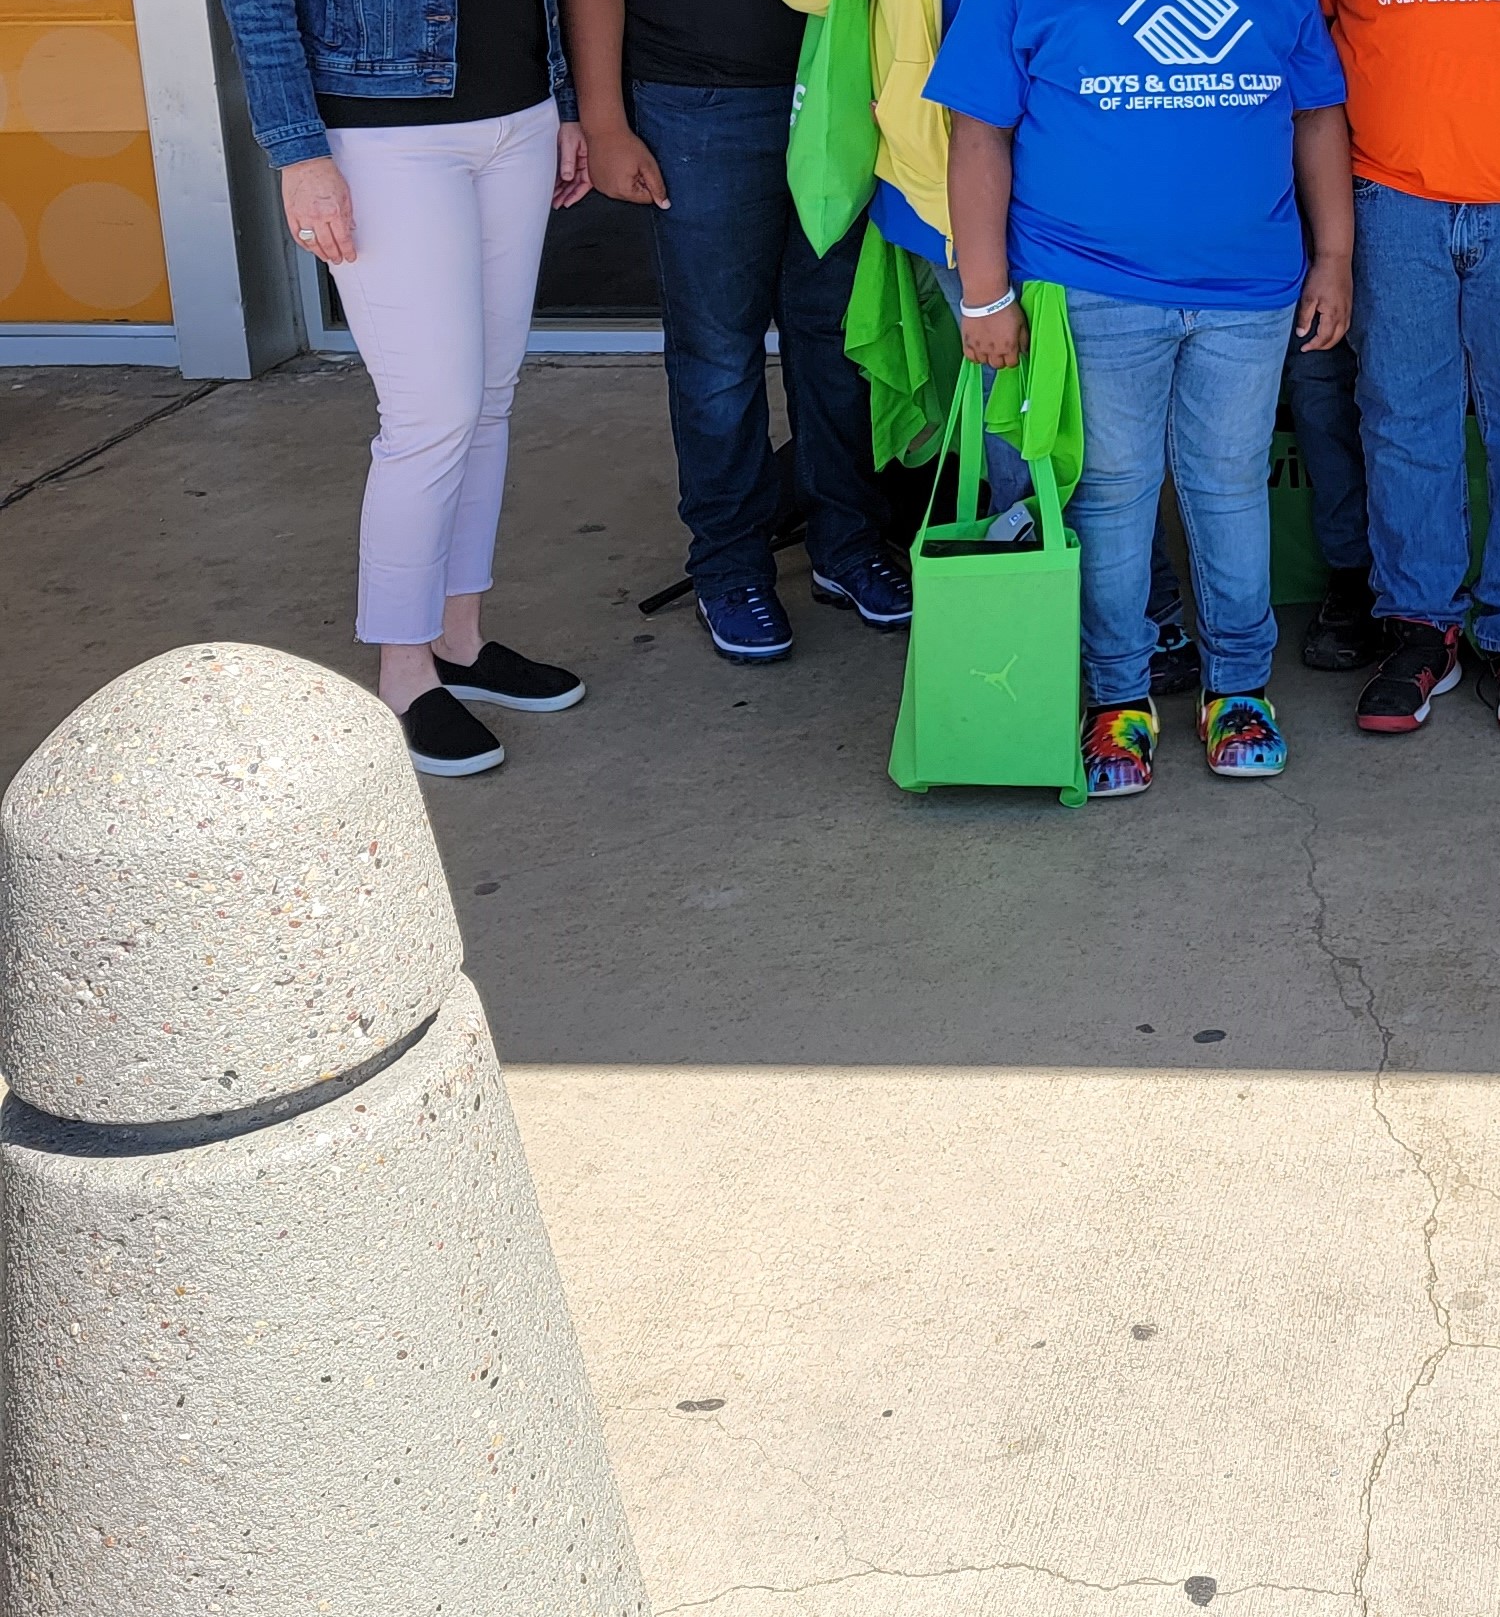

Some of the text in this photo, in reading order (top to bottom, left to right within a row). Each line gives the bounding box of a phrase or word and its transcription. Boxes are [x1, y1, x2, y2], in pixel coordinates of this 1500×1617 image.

[1079, 74, 1140, 94] BOYS
[1145, 74, 1166, 92] &
[1169, 73, 1235, 91] GIRLS
[1099, 97, 1122, 111] OF
[1125, 95, 1216, 110] JEFFERSON
